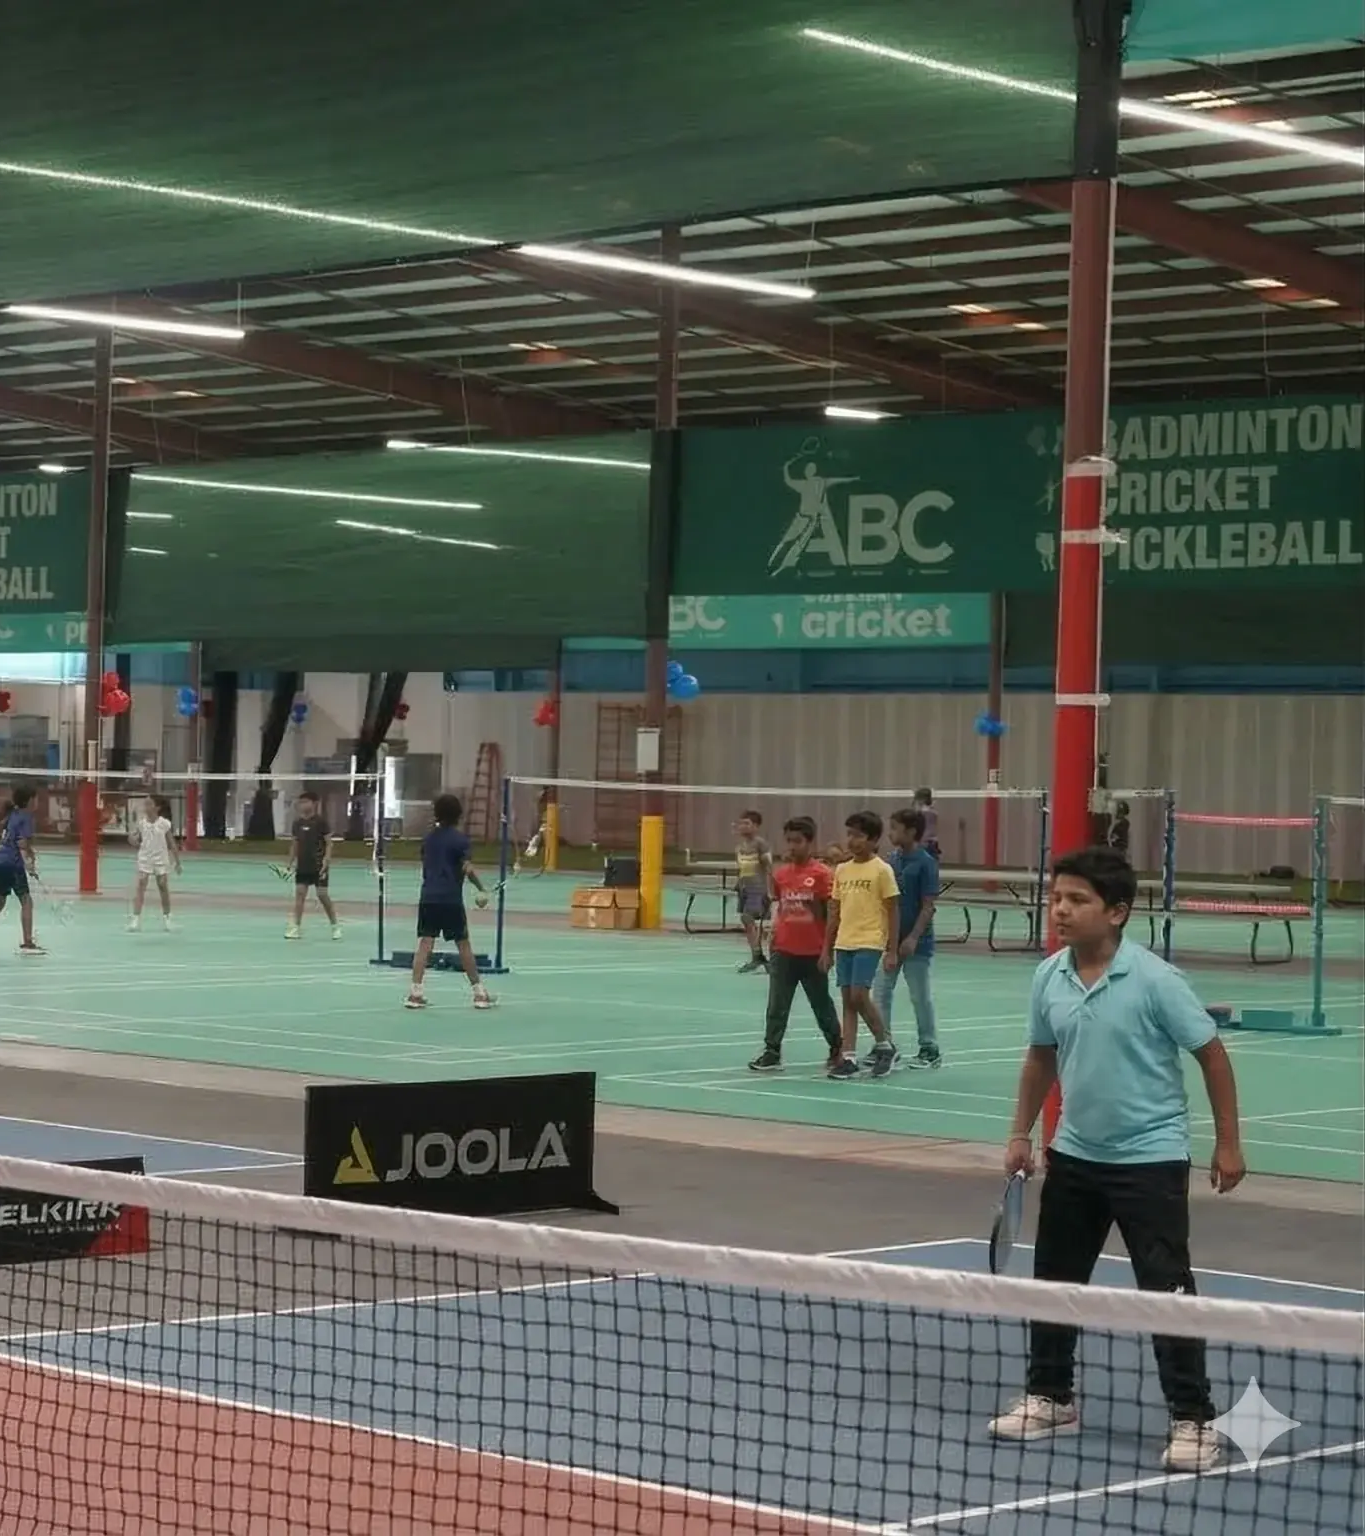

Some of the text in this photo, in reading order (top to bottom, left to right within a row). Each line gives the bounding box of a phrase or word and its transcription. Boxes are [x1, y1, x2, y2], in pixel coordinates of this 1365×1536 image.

[1102, 465, 1278, 515] CRICKET
[782, 490, 955, 566] ABC
[801, 603, 952, 638] cricket
[385, 1122, 570, 1182] JOOLA
